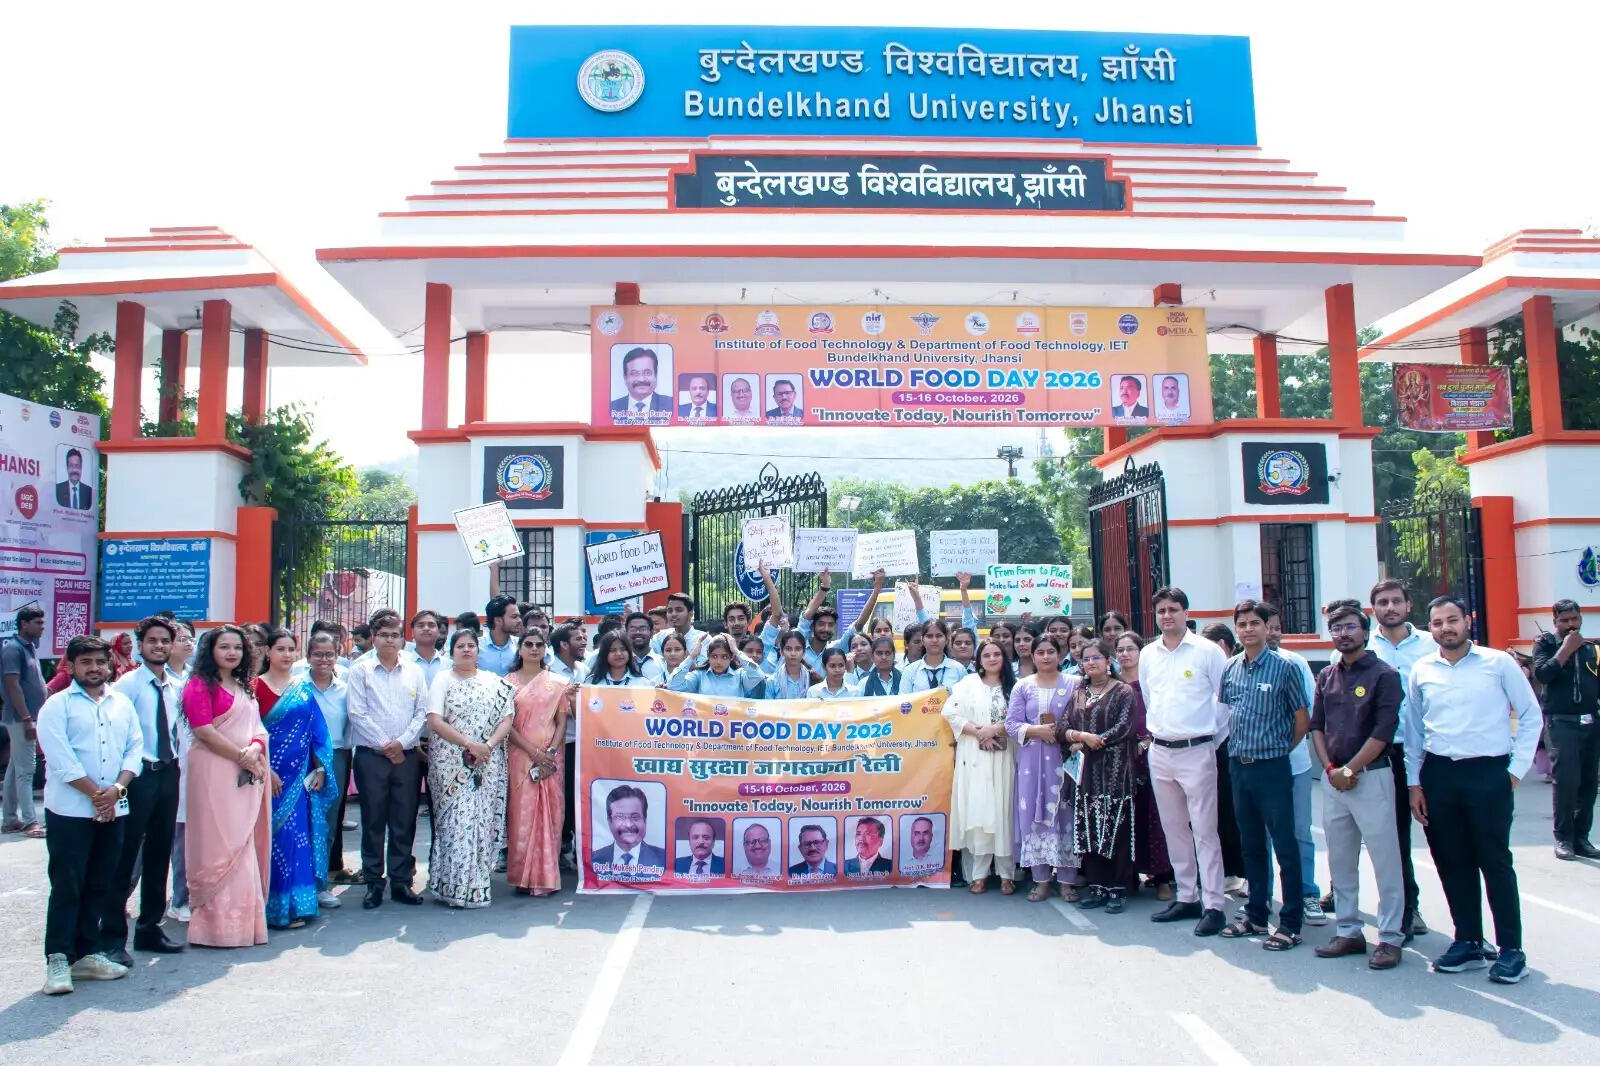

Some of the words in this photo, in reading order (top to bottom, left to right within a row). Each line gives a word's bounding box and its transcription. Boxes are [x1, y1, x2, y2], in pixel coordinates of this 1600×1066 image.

[698, 40, 864, 82] बुन्देलखण्ड
[883, 42, 1087, 82] विश्वविद्यालय,
[1101, 43, 1176, 81] झाँसी
[684, 89, 890, 119] Bundelkhand
[909, 91, 1078, 128] University,
[1095, 96, 1193, 125] Jhansi
[715, 160, 850, 206] बुन्देलखण्ड
[715, 339, 765, 349] Institute
[770, 339, 782, 349] of
[785, 340, 817, 349] Food
[822, 340, 892, 352] Technology
[896, 340, 906, 349] &
[910, 340, 981, 351] Department
[985, 340, 996, 350] of
[1000, 341, 1030, 350] Food
[1034, 341, 1106, 352] Technology,
[1110, 341, 1129, 350] IET
[827, 353, 909, 362] Bundelkhand
[913, 354, 978, 365] University,
[982, 354, 1022, 363] Jhansi
[810, 369, 903, 387] WORLD
[910, 369, 981, 387] FOOD
[988, 370, 1039, 388] DAY
[1044, 372, 1101, 388] 2026
[898, 394, 931, 402] 15-16
[935, 394, 987, 404] October,
[991, 394, 1019, 402] 2026
[812, 408, 890, 421] "Innovate
[894, 409, 948, 423] Today,
[953, 409, 1013, 421] Nourish
[1016, 409, 1101, 422] Tomorrow"
[994, 566, 1014, 578] From
[1040, 566, 1048, 575] to
[55, 580, 72, 589] SCAN
[74, 581, 91, 590] HERE
[1020, 578, 1034, 588] Safe
[1037, 579, 1048, 587] and
[1050, 579, 1069, 588] Great
[645, 718, 724, 737] WORLD
[730, 722, 791, 739] FOOD
[797, 723, 842, 740] DAY
[846, 722, 892, 739] 2026
[595, 739, 623, 748] Institute
[624, 740, 633, 748] of
[633, 741, 651, 749] Food
[654, 741, 694, 751] Technology
[695, 741, 701, 749] &
[703, 743, 744, 751] Department
[745, 743, 753, 751] of
[754, 744, 772, 752] Food
[775, 745, 816, 754] Technology,
[877, 740, 912, 749] University,
[914, 739, 938, 748] Jhansi
[688, 759, 749, 779] सुरक्षा
[855, 753, 902, 773] रैली
[744, 785, 772, 793] 15-16
[775, 784, 818, 793] October,
[821, 783, 846, 792] 2026
[684, 800, 748, 812] "Innovate
[752, 800, 797, 812] Today,
[801, 799, 851, 811] Nourish
[855, 797, 928, 810] Tomorrow"
